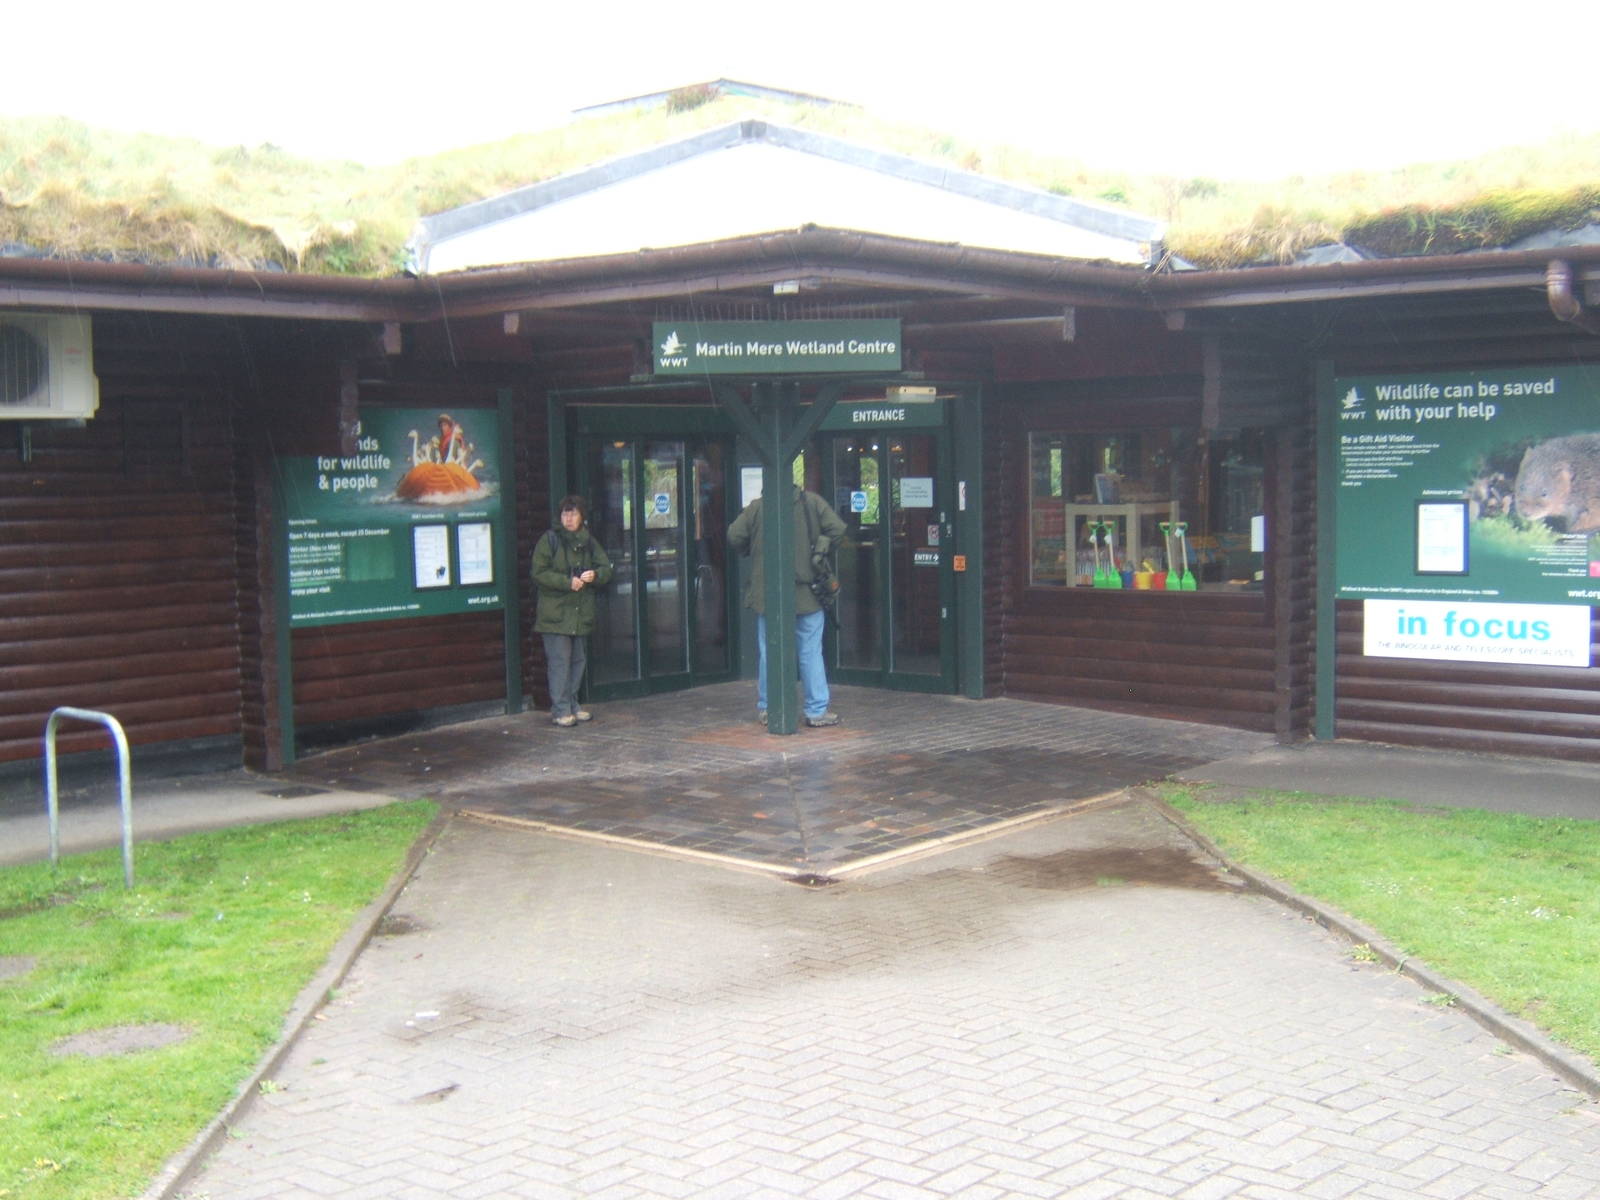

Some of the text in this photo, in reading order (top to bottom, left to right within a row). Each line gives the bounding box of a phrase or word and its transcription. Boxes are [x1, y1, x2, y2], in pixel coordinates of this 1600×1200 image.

[695, 339, 897, 357] Martin Mere Wetland Centre
[660, 357, 688, 367] WWT
[1375, 378, 1555, 401] Wildlife can be saved
[852, 409, 905, 422] ENTRANCE
[1340, 411, 1366, 420] WWT
[1375, 401, 1496, 423] with your help
[317, 454, 391, 471] for wildlife
[318, 473, 378, 492] & people
[914, 553, 932, 561] ENTRY
[1398, 608, 1551, 641] in focus
